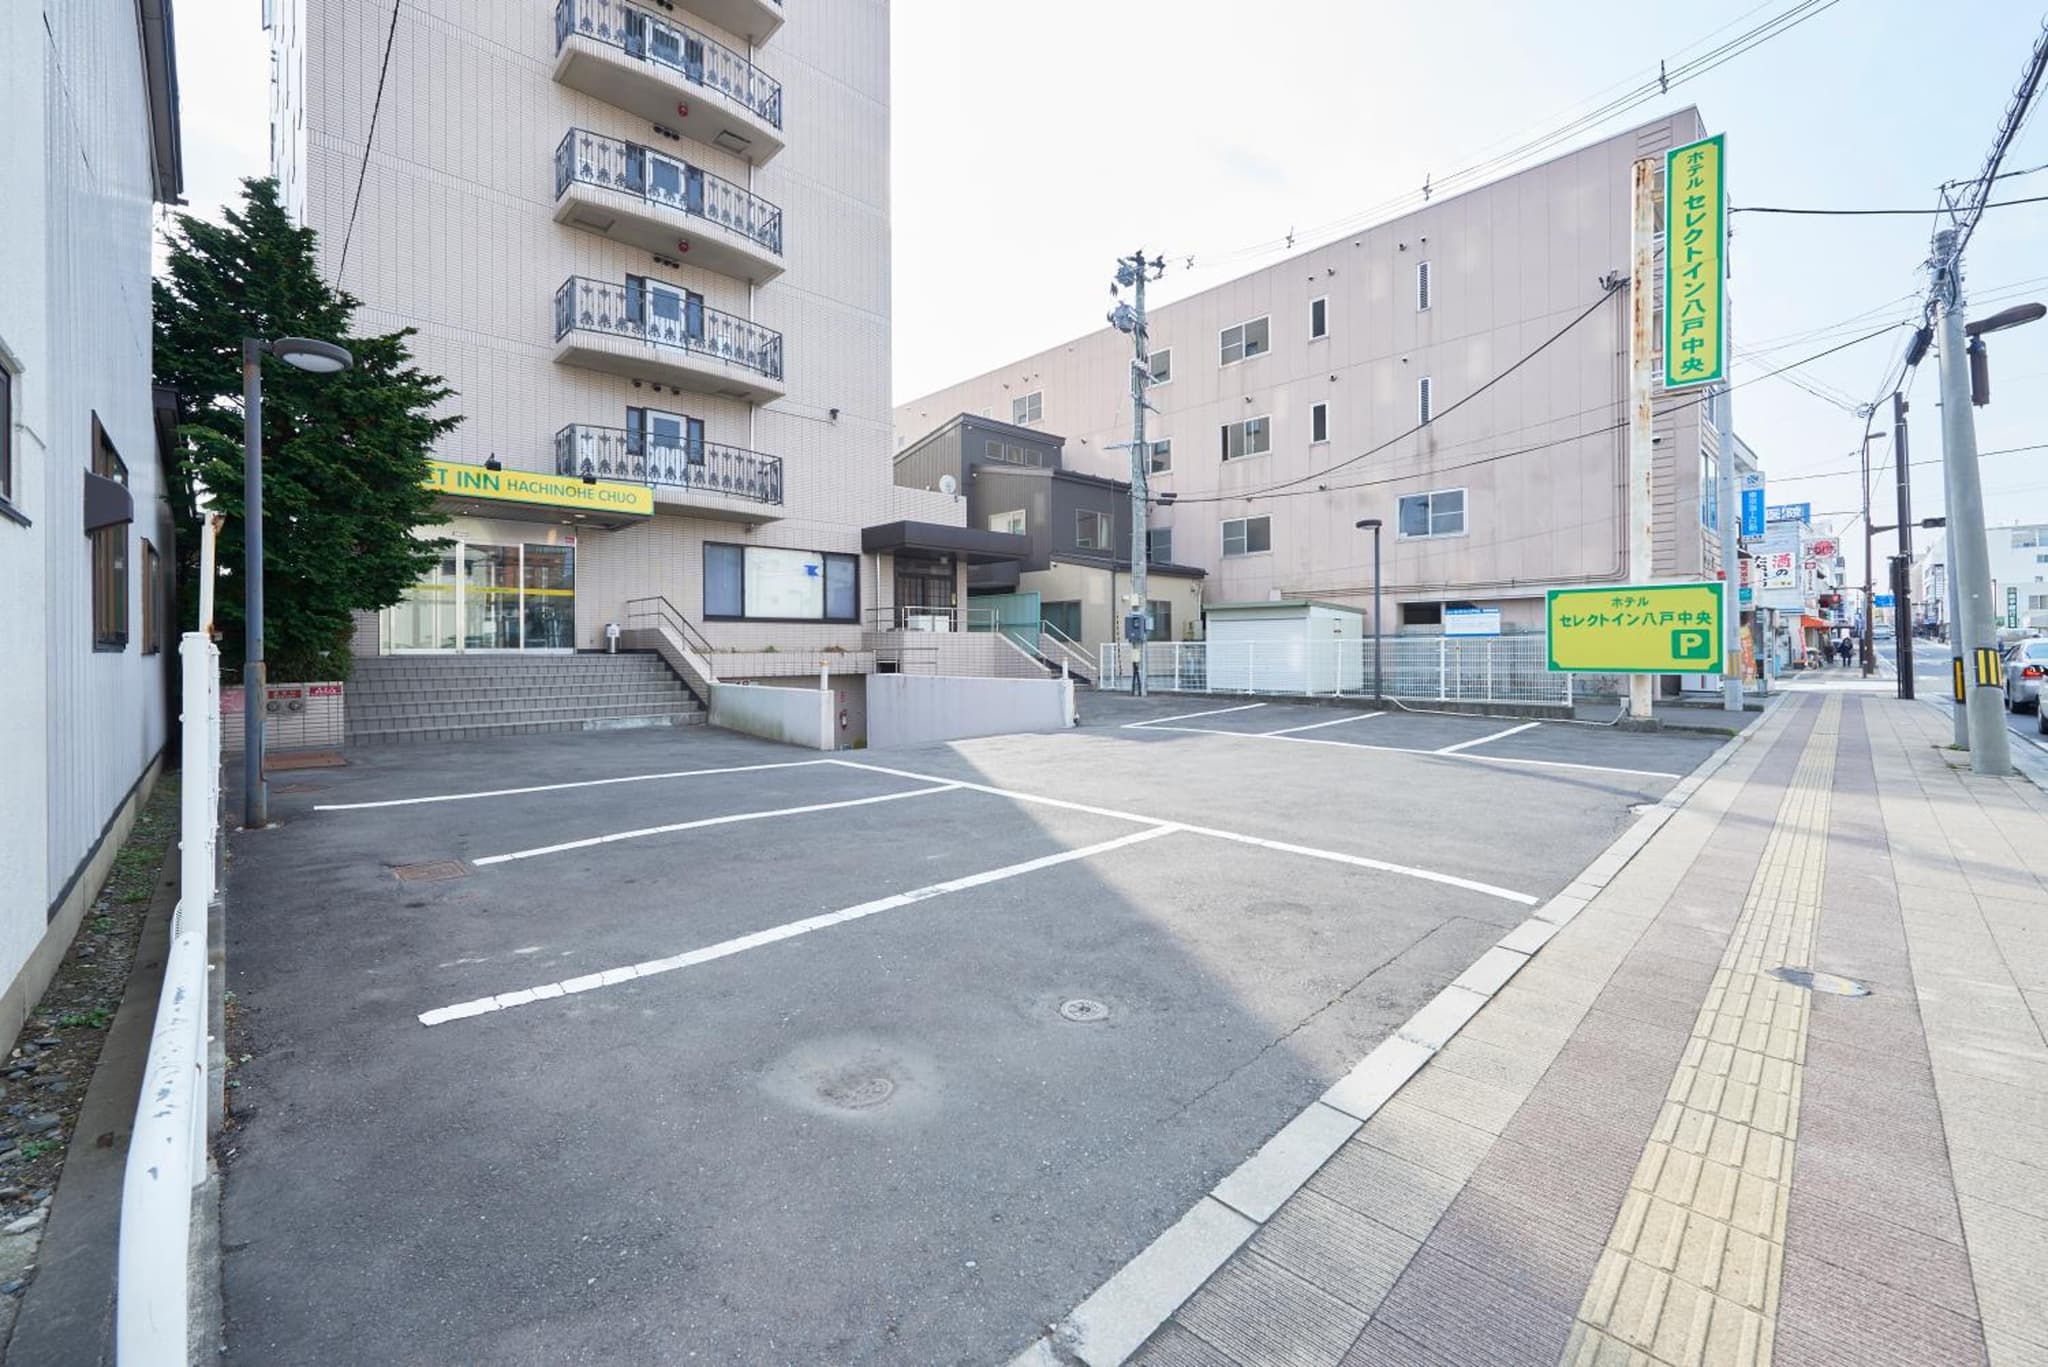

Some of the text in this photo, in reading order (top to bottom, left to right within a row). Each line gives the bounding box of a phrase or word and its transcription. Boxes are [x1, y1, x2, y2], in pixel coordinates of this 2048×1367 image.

[1681, 151, 1706, 375] ホテル セレクトイン八戸中央
[457, 471, 500, 492] INN
[507, 480, 595, 501] HACHINOHE
[598, 489, 638, 505] CHUO
[1611, 596, 1650, 608] ホテル
[1560, 610, 1713, 628] セレクトイン八戸中央
[1679, 633, 1703, 656] P
